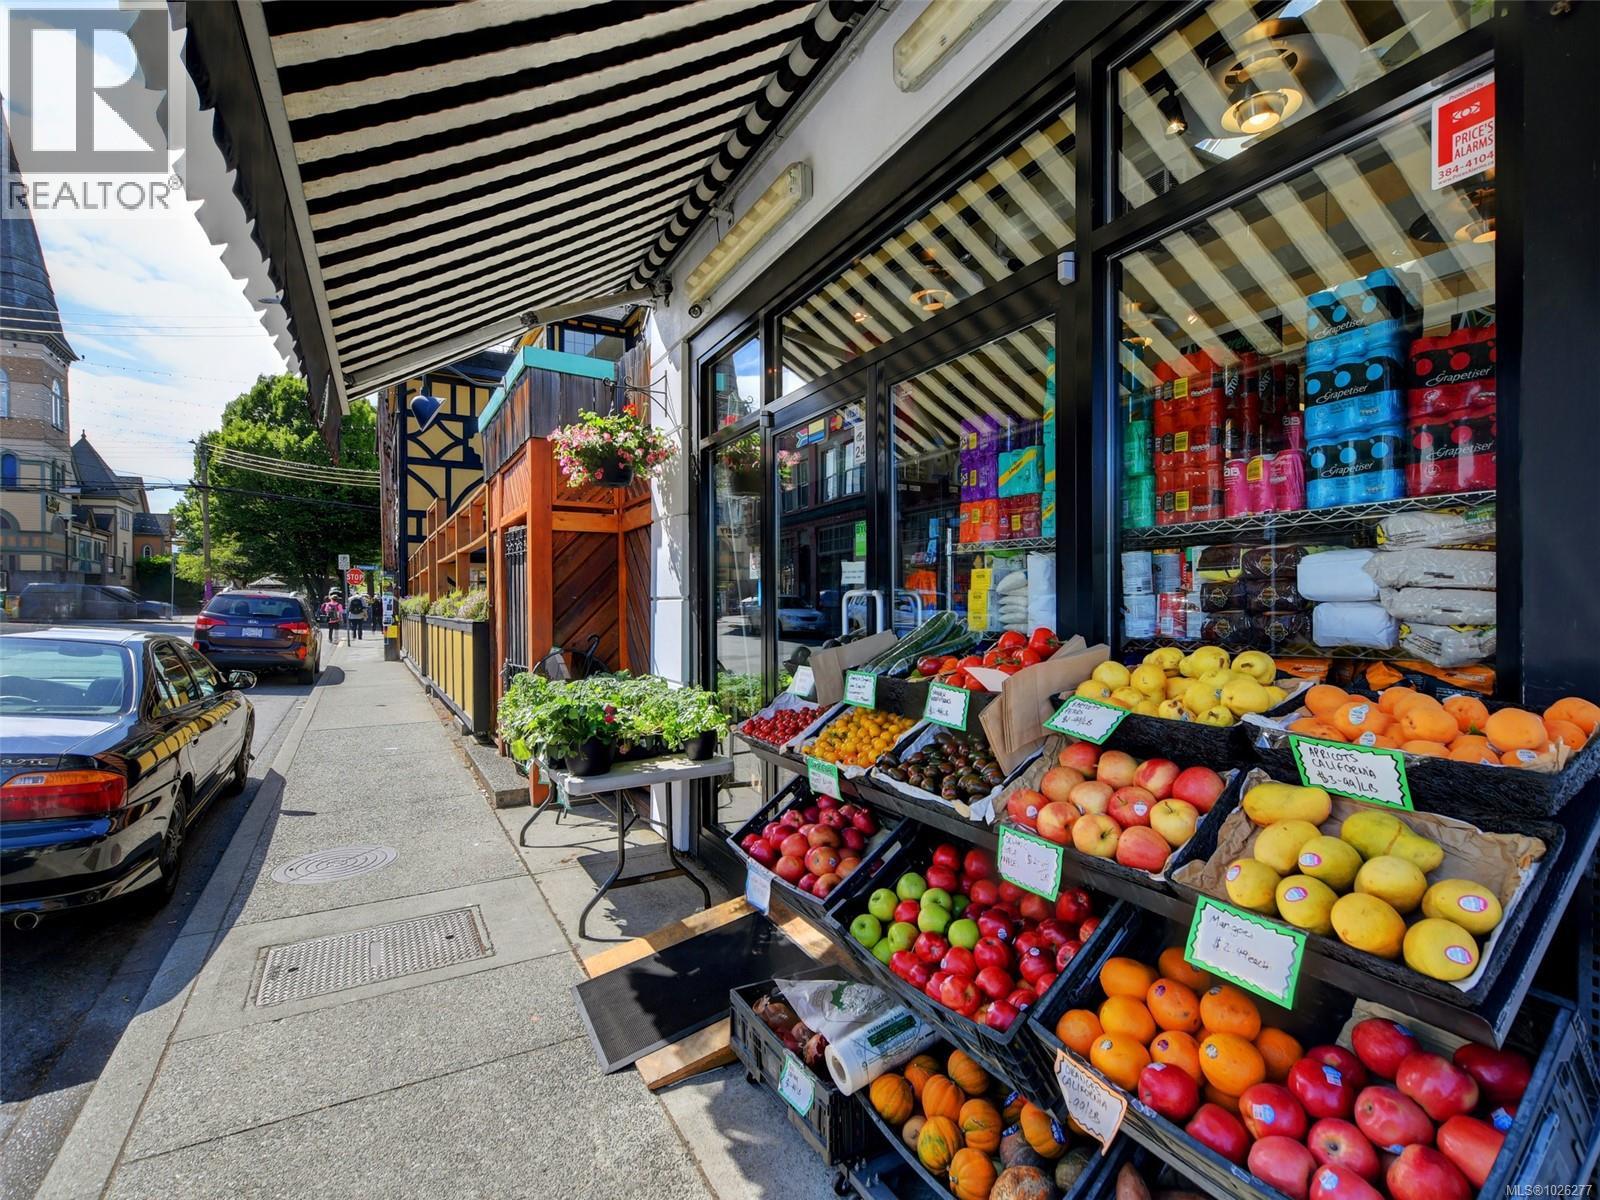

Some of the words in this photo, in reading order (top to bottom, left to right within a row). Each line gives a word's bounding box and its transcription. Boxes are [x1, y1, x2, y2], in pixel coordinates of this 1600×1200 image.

[1455, 121, 1494, 147] PRICE'S
[1454, 134, 1494, 160] ALARMS
[1438, 151, 1494, 180] 384-4104
[1314, 318, 1365, 339] Grapetiser
[1425, 366, 1491, 387] Grapetiser
[1316, 384, 1368, 404] Grapetiser
[1426, 440, 1493, 461] Grapetiser
[1321, 462, 1373, 478] Grapetiser
[1308, 746, 1358, 763] APRICOTS
